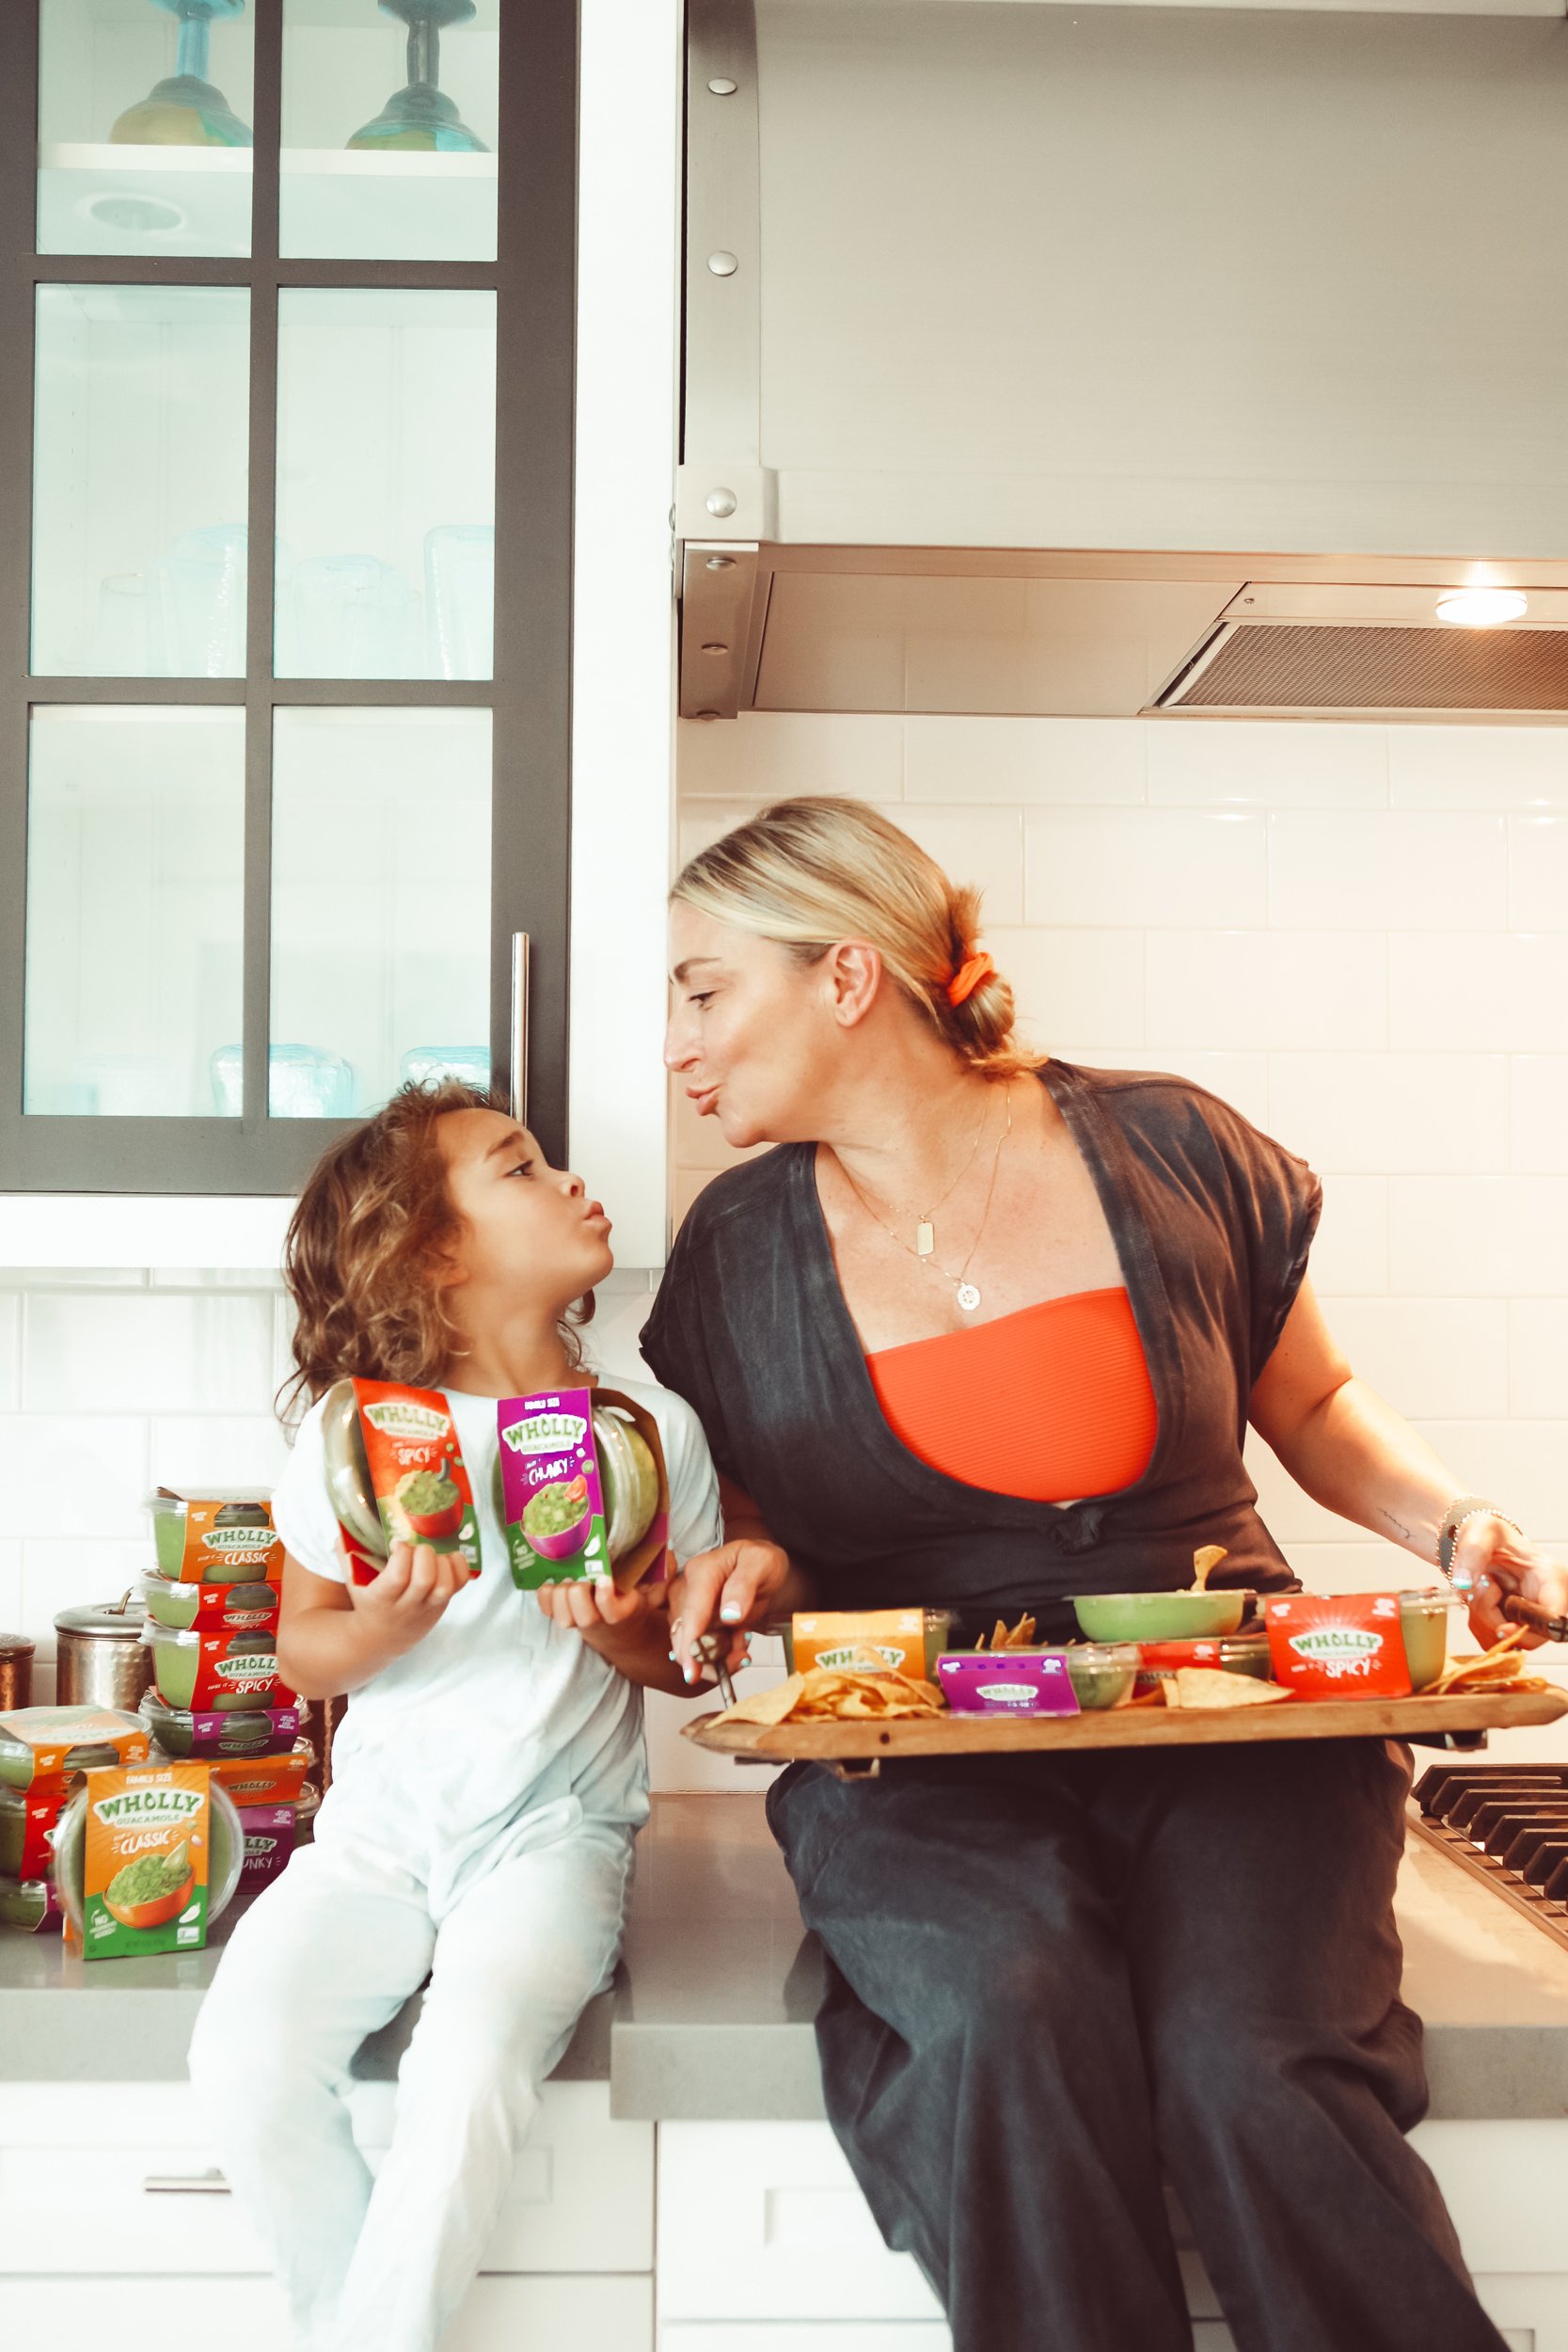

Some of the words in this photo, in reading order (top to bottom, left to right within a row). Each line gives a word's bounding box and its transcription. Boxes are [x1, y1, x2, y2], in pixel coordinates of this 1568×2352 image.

[367, 1406, 447, 1433] WHOLLY
[506, 1417, 583, 1445] WHOLLY
[397, 1445, 431, 1466] SPICY
[528, 1457, 568, 1486] CHUNKY
[204, 1529, 277, 1546] WHOLLY
[224, 1551, 270, 1565] CLASSIC
[225, 1613, 271, 1621] WHOLLY
[1295, 1633, 1379, 1651] WHOLLY
[217, 1657, 278, 1675] WHOLL
[819, 1650, 901, 1667] WHY
[1324, 1657, 1371, 1679] SPICY
[235, 1677, 274, 1694] SPICY
[220, 1740, 267, 1750] WHOLLY
[126, 1774, 154, 1785] FAMILY
[155, 1772, 173, 1783] SIZE
[227, 1781, 276, 1790] WHOLLY
[99, 1791, 200, 1820] WHOLLY
[117, 1814, 181, 1826] GUACAMOLE
[120, 1828, 171, 1855] CLASSIC
[245, 1837, 275, 1851] LLY
[243, 1856, 273, 1870] UNKY
